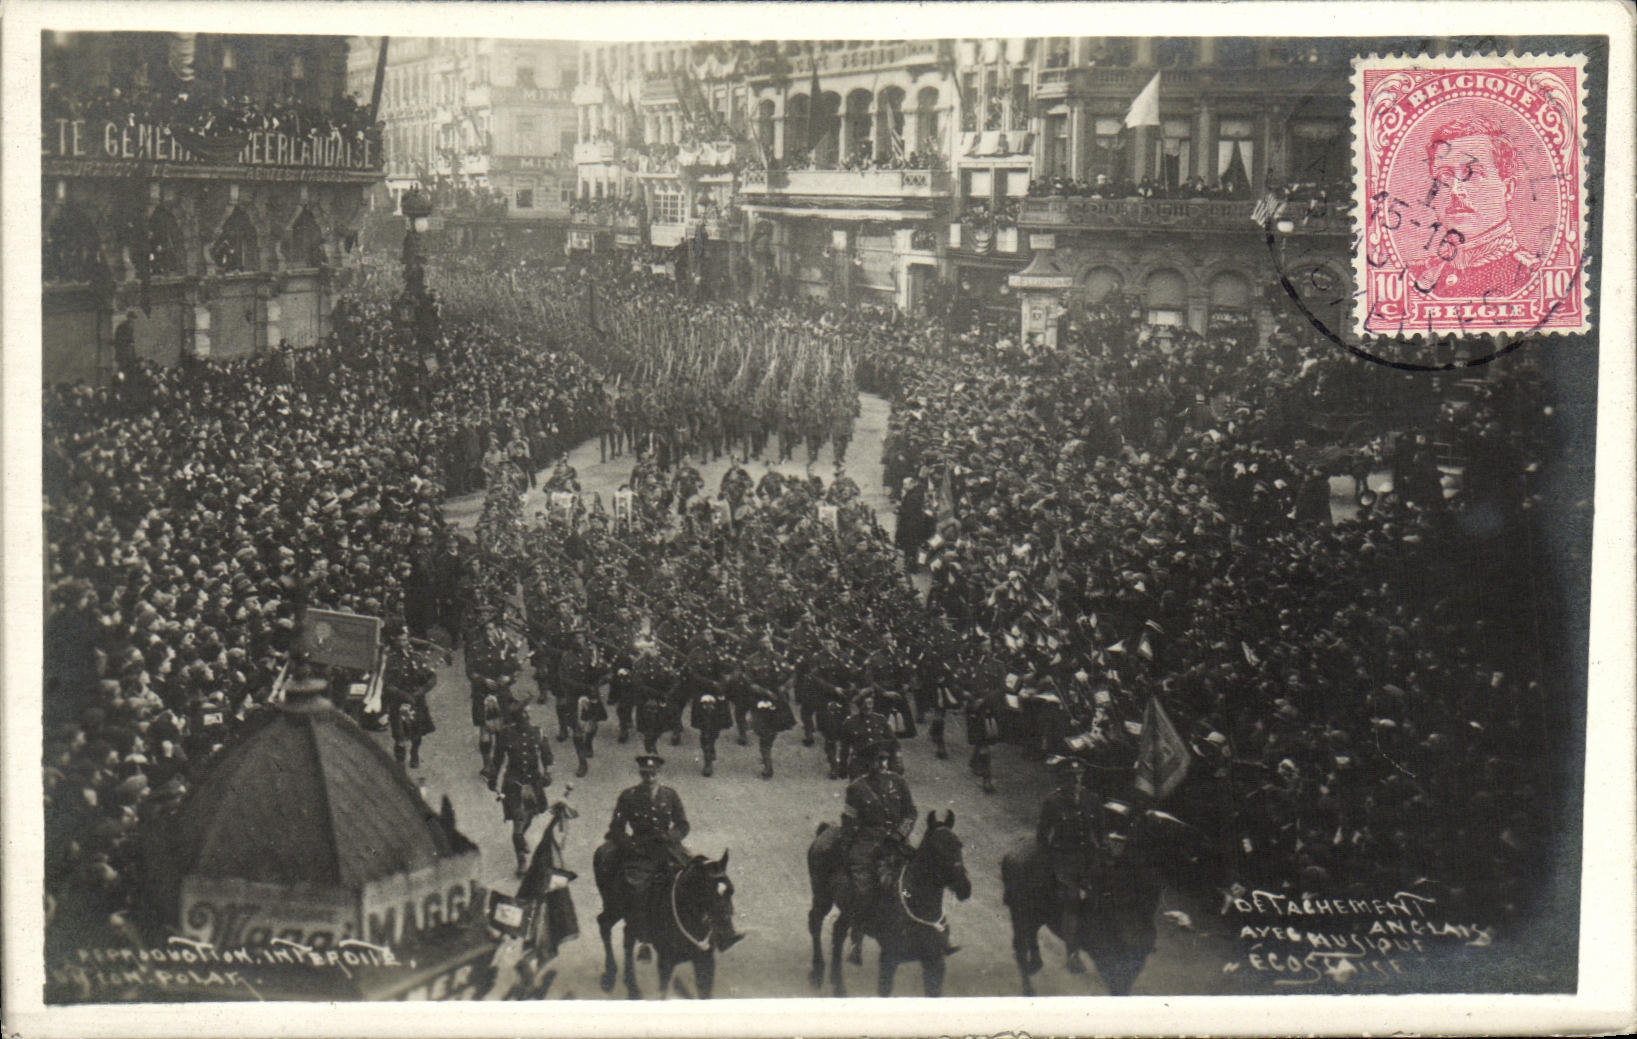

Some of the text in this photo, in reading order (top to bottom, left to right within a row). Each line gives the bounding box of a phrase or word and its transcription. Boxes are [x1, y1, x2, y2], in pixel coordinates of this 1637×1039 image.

[1409, 74, 1538, 109] BELGIQUE
[1375, 273, 1402, 301] 10
[1543, 269, 1569, 299] 10
[1423, 303, 1526, 318] BELGIE
